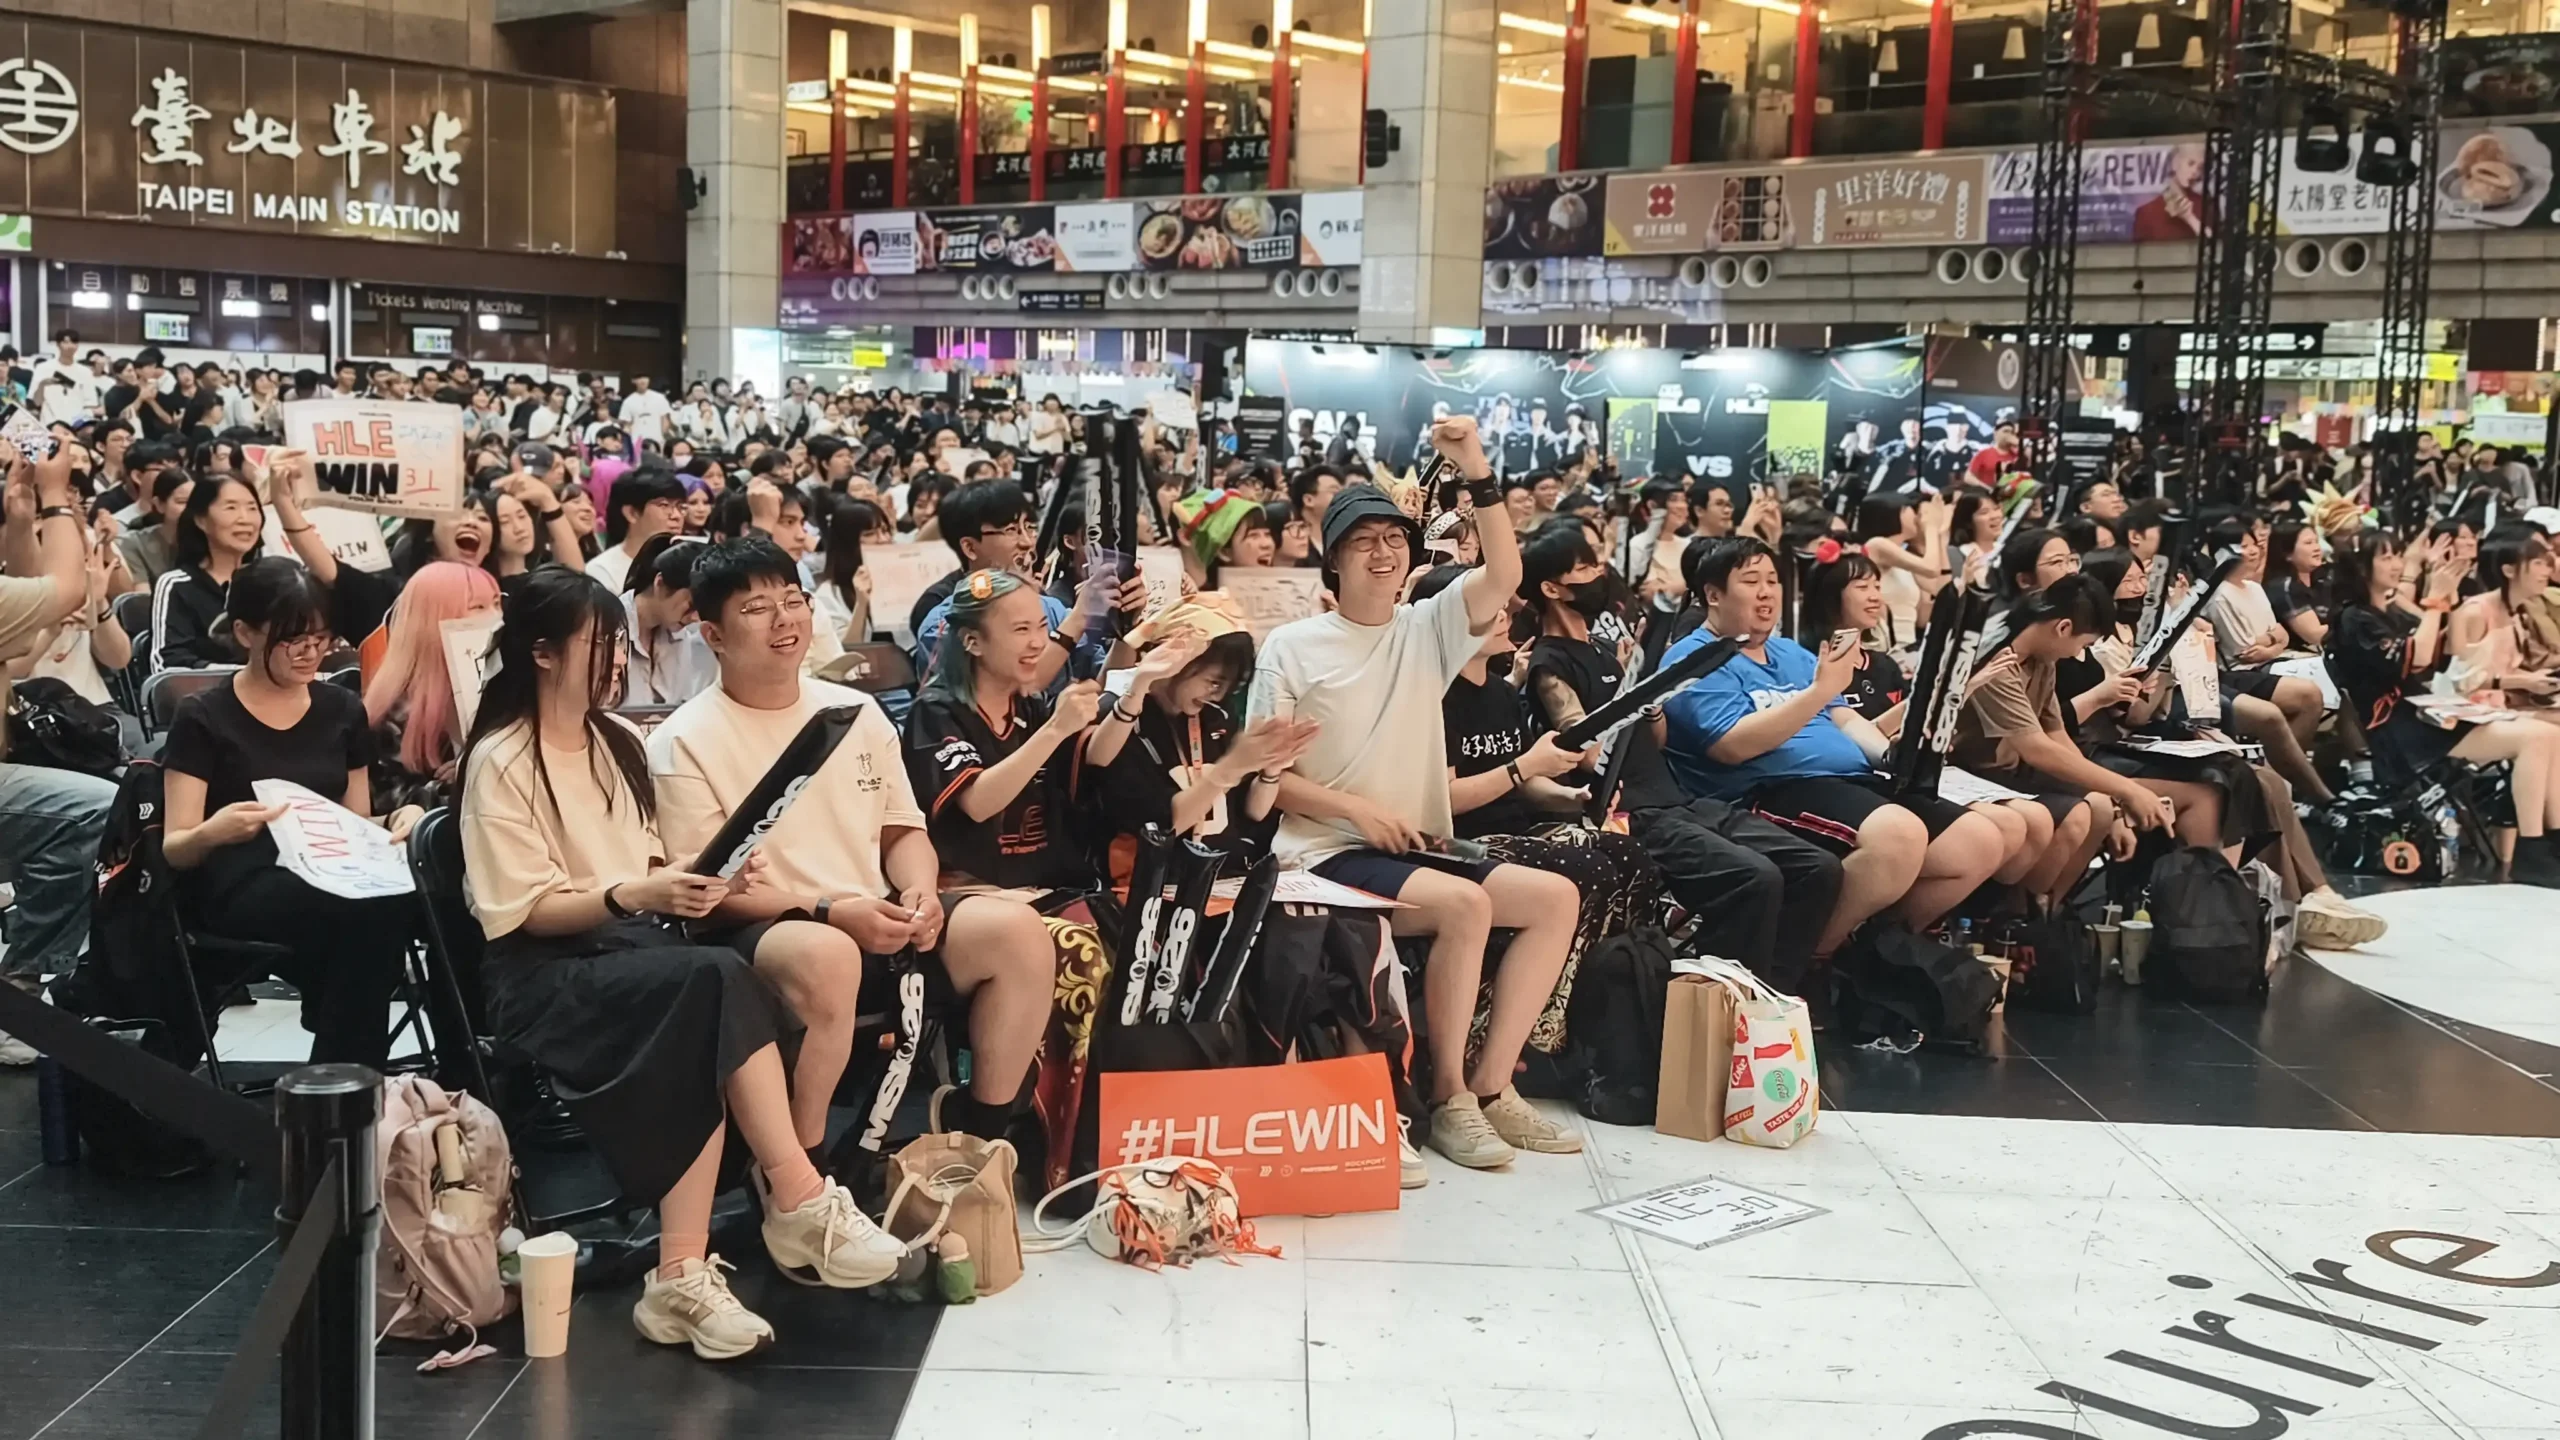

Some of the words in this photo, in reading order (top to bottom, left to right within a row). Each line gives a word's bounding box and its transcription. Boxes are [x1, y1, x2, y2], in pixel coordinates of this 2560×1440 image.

[131, 67, 462, 188] 臺北車站
[1836, 168, 1949, 208] 里洋好禮
[2287, 183, 2389, 213] 太陽堂老店
[138, 182, 233, 215] TAIPEI
[254, 193, 327, 222] MAIN
[346, 200, 459, 233] STATION
[82, 271, 289, 302] 自動售票機
[367, 291, 416, 308] Tickets
[422, 296, 470, 312] Vending
[476, 300, 525, 314] Machine
[312, 420, 397, 458] HLE
[314, 462, 399, 496] WIN
[1686, 455, 1733, 477] VS
[1118, 1099, 1387, 1164] #HLEWIN
[1616, 1196, 1713, 1227] HLE
[1920, 1229, 2560, 1440] urire
